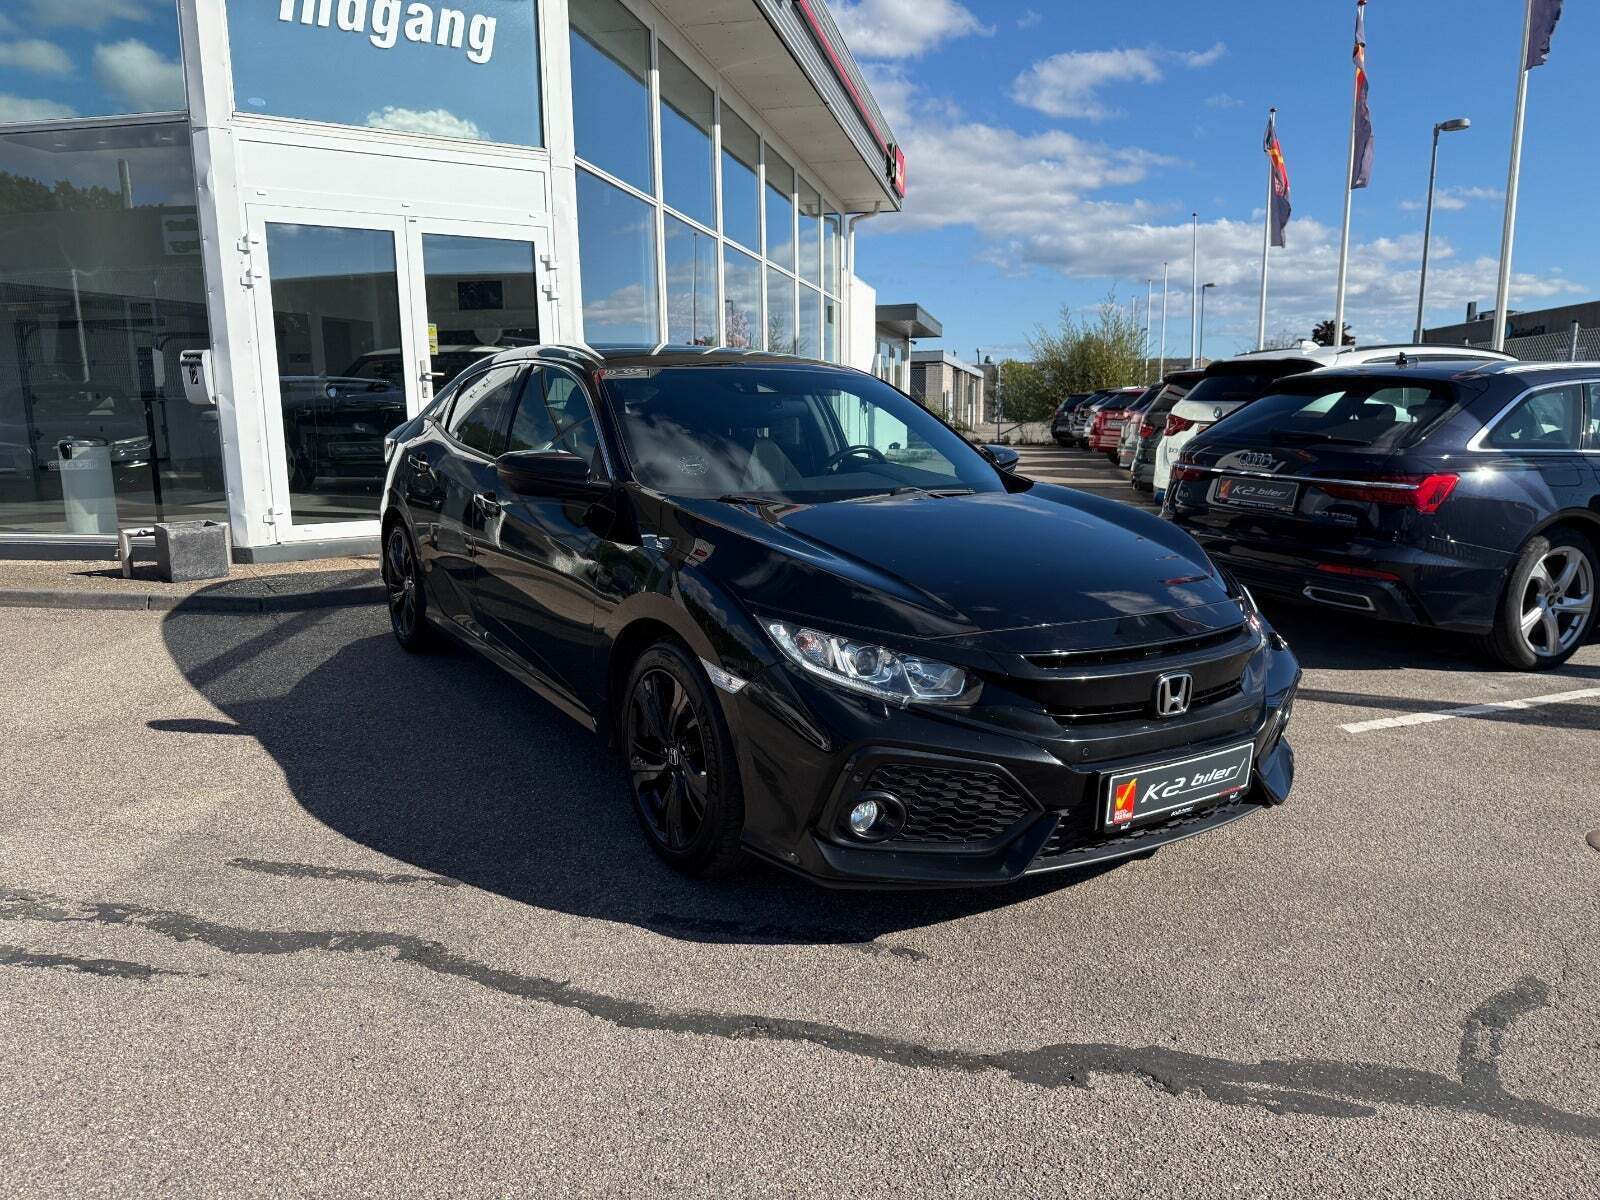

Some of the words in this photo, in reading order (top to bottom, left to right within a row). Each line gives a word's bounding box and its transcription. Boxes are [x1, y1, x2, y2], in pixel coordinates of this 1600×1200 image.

[1232, 484, 1256, 496] K2
[1140, 777, 1187, 804] K2
[1190, 765, 1238, 787] biler
